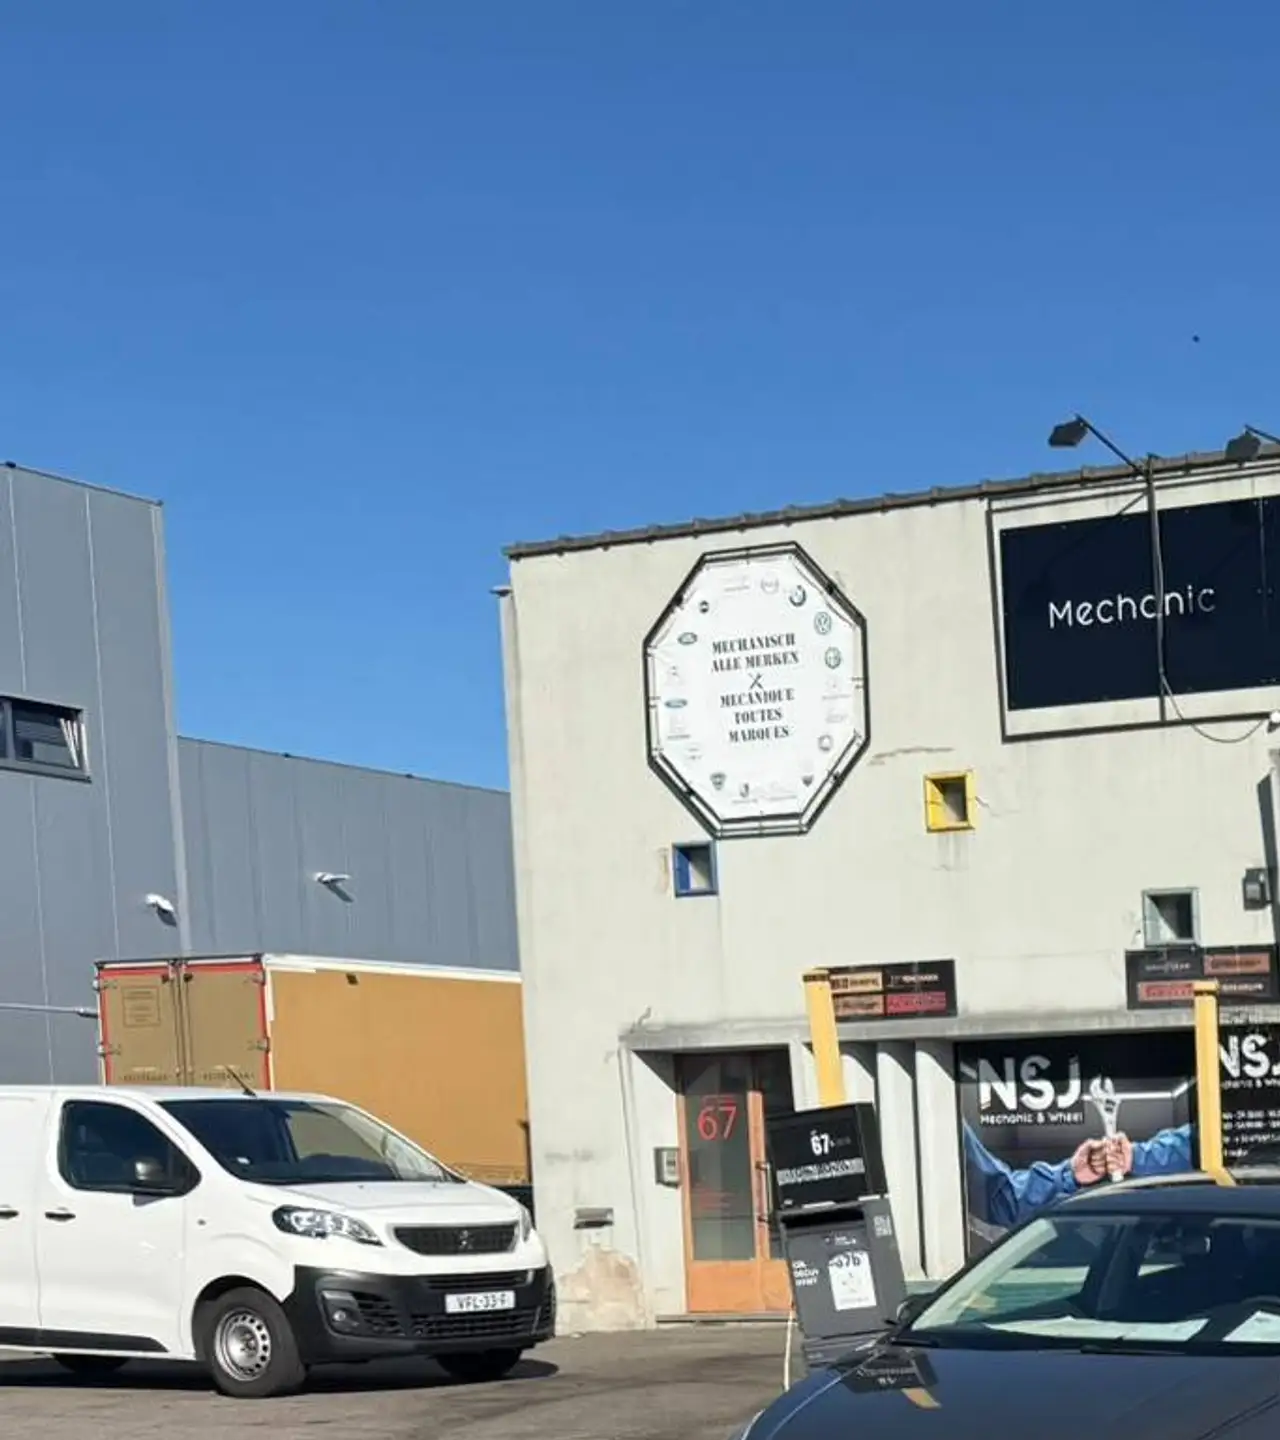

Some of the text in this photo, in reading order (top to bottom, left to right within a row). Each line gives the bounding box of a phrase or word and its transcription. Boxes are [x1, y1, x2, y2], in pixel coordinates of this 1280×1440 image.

[979, 1055, 1081, 1111] NSJ
[698, 1105, 737, 1140] 67
[811, 1132, 830, 1156] 67
